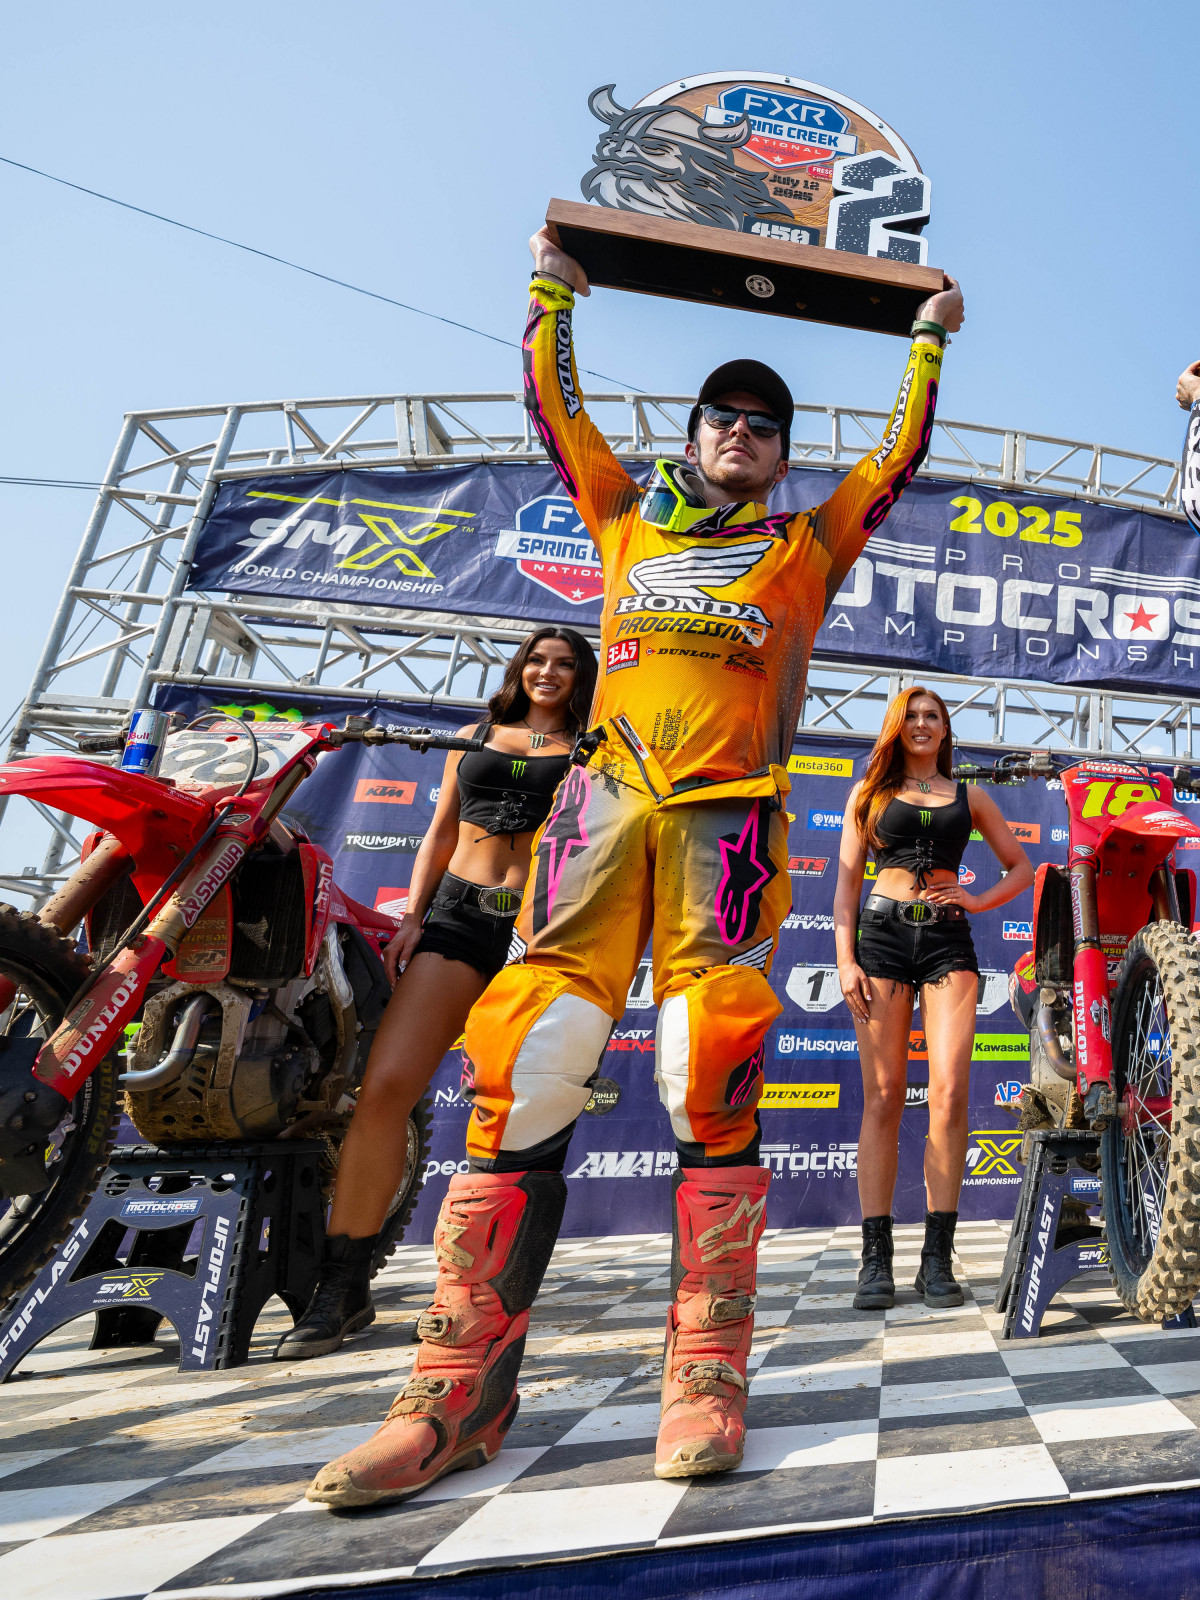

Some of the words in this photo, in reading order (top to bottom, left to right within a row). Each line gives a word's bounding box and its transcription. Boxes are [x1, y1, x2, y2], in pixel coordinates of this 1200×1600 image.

[744, 92, 826, 126] FXR
[724, 114, 783, 136] SRING
[787, 126, 840, 148] CREEK
[751, 136, 822, 155] ATIONAL
[768, 174, 800, 190] July
[803, 180, 820, 191] 12
[772, 186, 813, 202] 2025
[830, 153, 930, 266] 2
[751, 221, 810, 246] 450
[871, 368, 915, 470] HONDA
[948, 495, 1084, 548] 2025
[236, 511, 458, 580] SMX
[516, 538, 588, 560] SPRING
[227, 563, 296, 581] WORLD
[301, 570, 444, 596] CHAMPIONSHIP
[945, 548, 1082, 581] PRO
[614, 595, 774, 629] HONDA
[616, 617, 762, 645] PROGRESSIVE
[608, 640, 637, 667] ヨシムラ
[657, 648, 721, 660] DUNLOP
[650, 712, 662, 750] SUPERTECH
[660, 708, 672, 750] ALPINESTARS
[670, 709, 682, 750] PRODUCTION
[795, 761, 843, 772] Insta360
[364, 786, 404, 798] KTM
[1081, 782, 1160, 819] 18
[346, 835, 406, 850] TRIUMPH
[194, 843, 244, 904] SHOWA
[788, 858, 827, 870] ETS
[63, 970, 140, 1078] DUNLOP
[1074, 980, 1088, 1065] DUNLOP
[974, 1042, 1030, 1052] Kawasaki
[764, 1090, 836, 1099] DUNLOP
[567, 1152, 653, 1179] AMA
[760, 1152, 858, 1170] OTOCR
[966, 1140, 1022, 1176] MX
[126, 1202, 198, 1212] MOTOCROSS
[1021, 1194, 1056, 1333] UFOPLAST
[0, 1218, 90, 1364] FOPLAST
[96, 1277, 158, 1298] SMX
[192, 1215, 230, 1364] UFOPLAST
